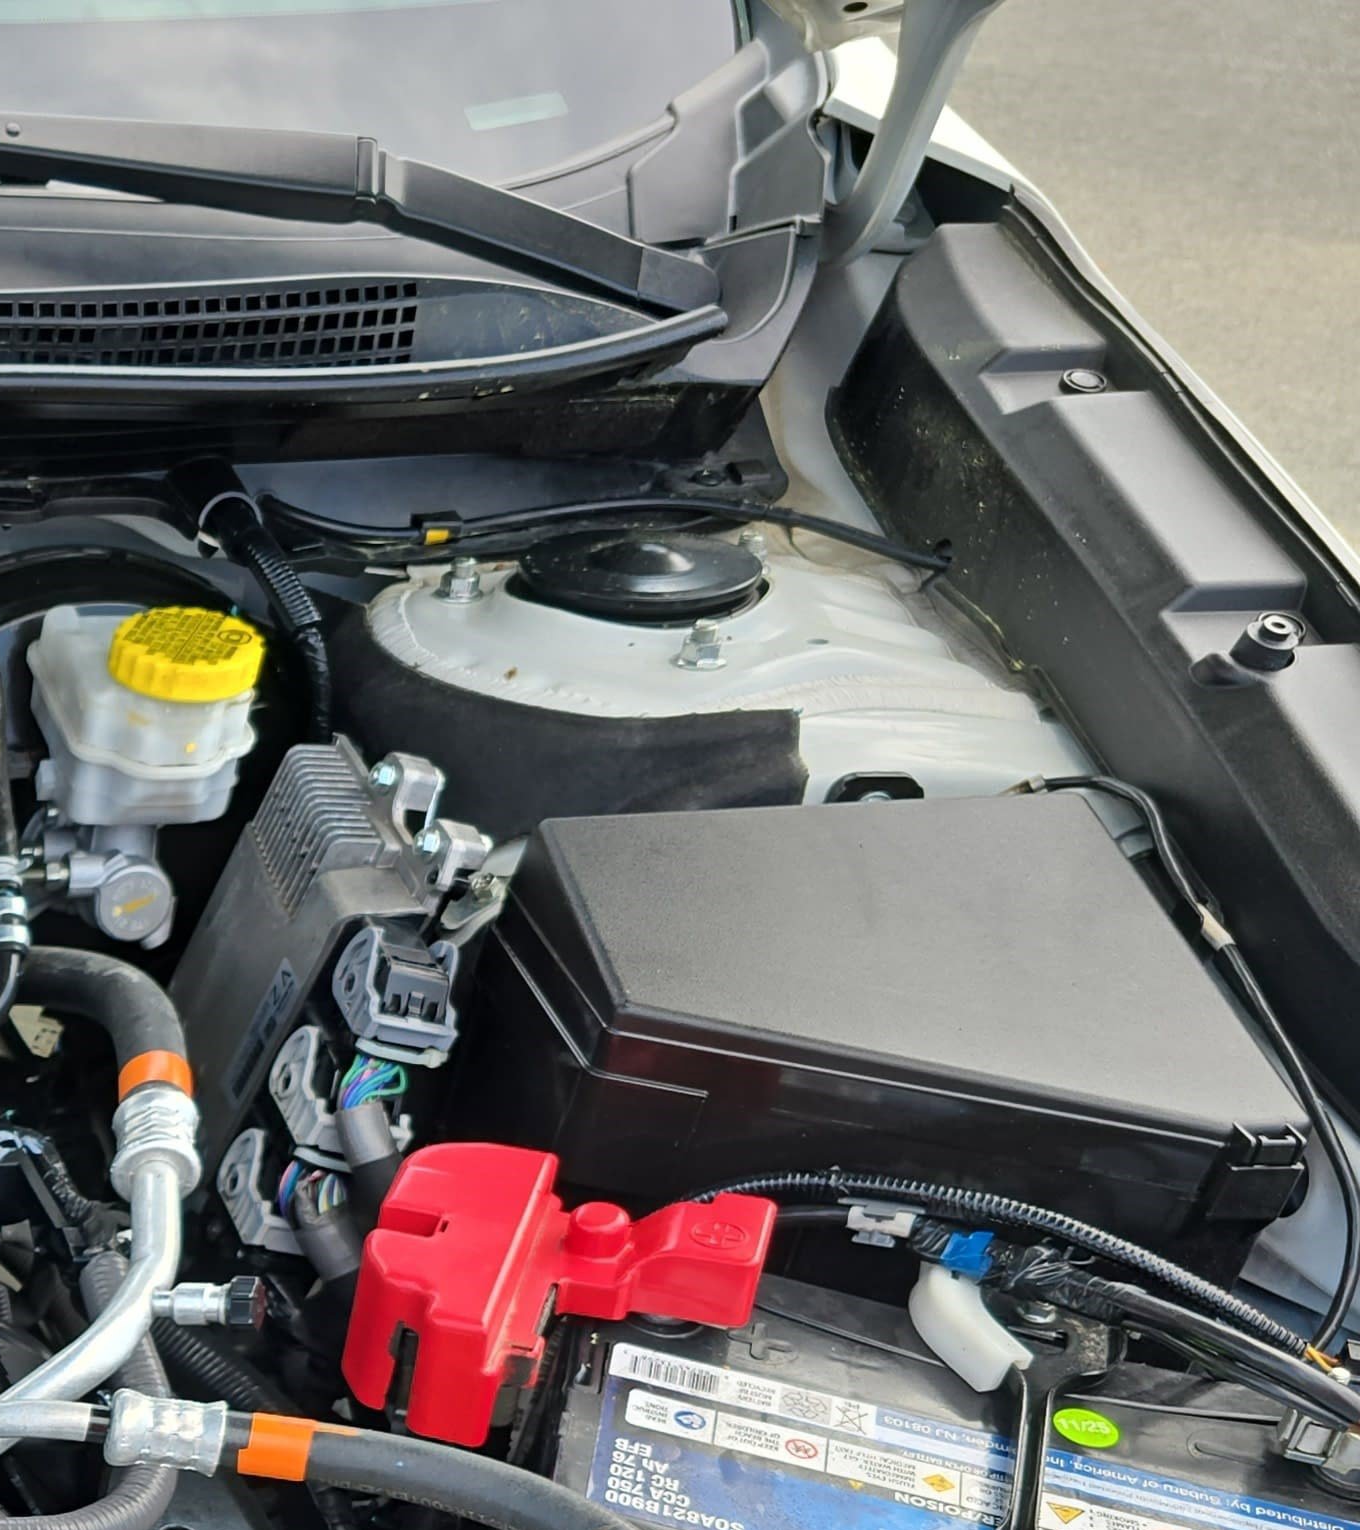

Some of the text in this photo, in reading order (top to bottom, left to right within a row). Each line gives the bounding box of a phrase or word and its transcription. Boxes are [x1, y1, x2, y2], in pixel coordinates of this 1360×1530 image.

[883, 1414, 931, 1434] 08103
[935, 1428, 957, 1441] NJ
[614, 1437, 653, 1458] EFB
[611, 1450, 637, 1467] 76
[609, 1463, 679, 1491] RC 120
[1142, 1478, 1158, 1490] of
[607, 1476, 690, 1507] CCA 750
[1163, 1483, 1222, 1505] Subaru
